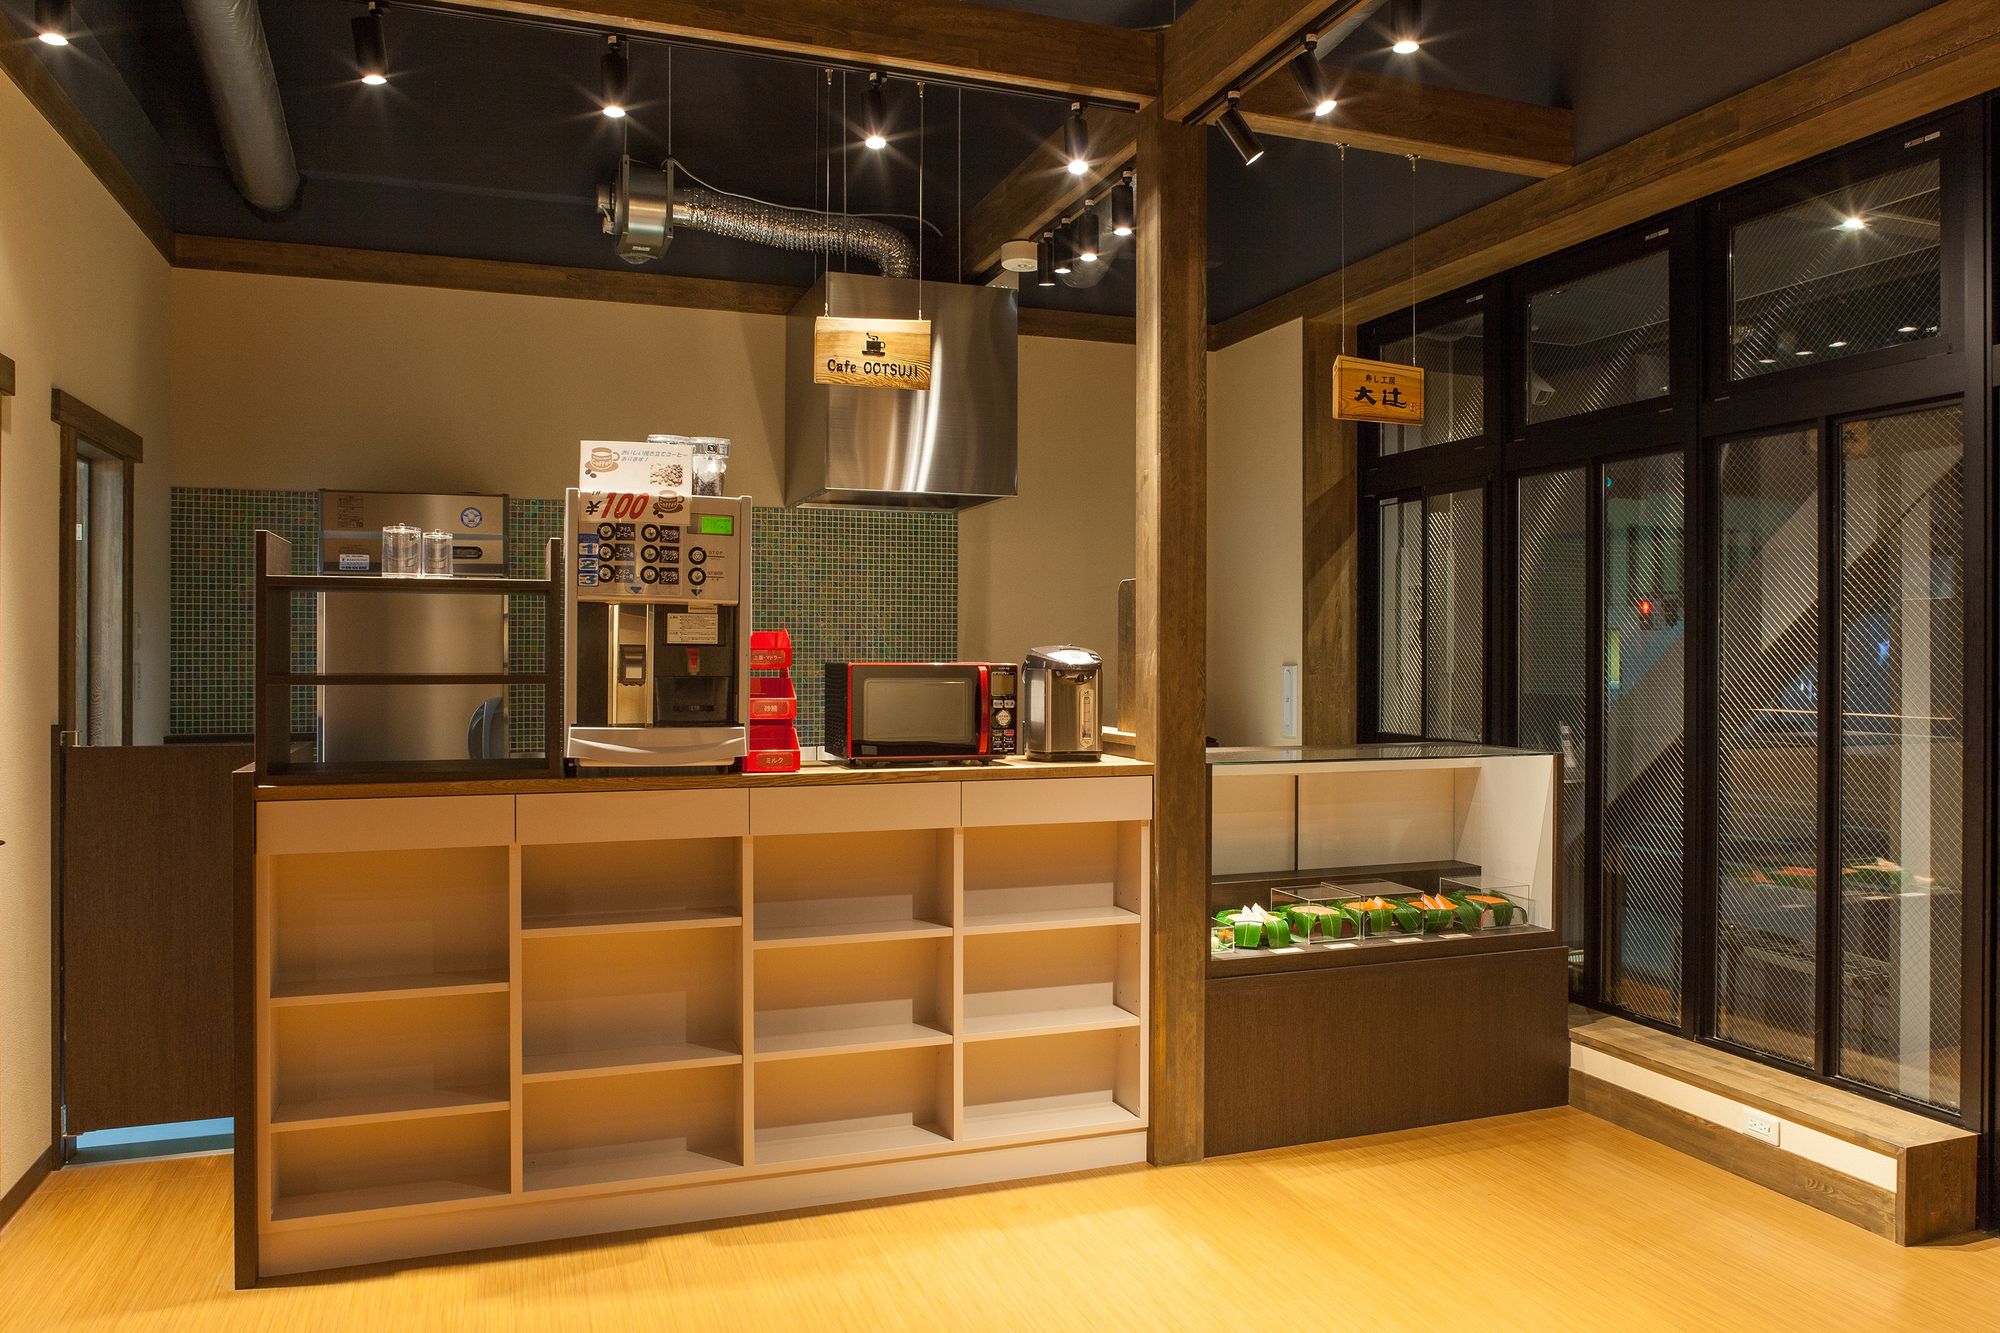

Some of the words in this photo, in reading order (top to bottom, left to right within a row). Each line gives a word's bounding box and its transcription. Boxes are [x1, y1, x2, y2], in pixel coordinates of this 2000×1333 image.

[827, 359, 857, 374] Cafe
[863, 361, 918, 378] OOTSUJI
[1365, 373, 1396, 385] 寿し工房
[1354, 386, 1407, 408] 大辻
[585, 492, 650, 519] ¥100
[763, 703, 778, 713] 砂糖
[765, 756, 784, 765] ミルク
